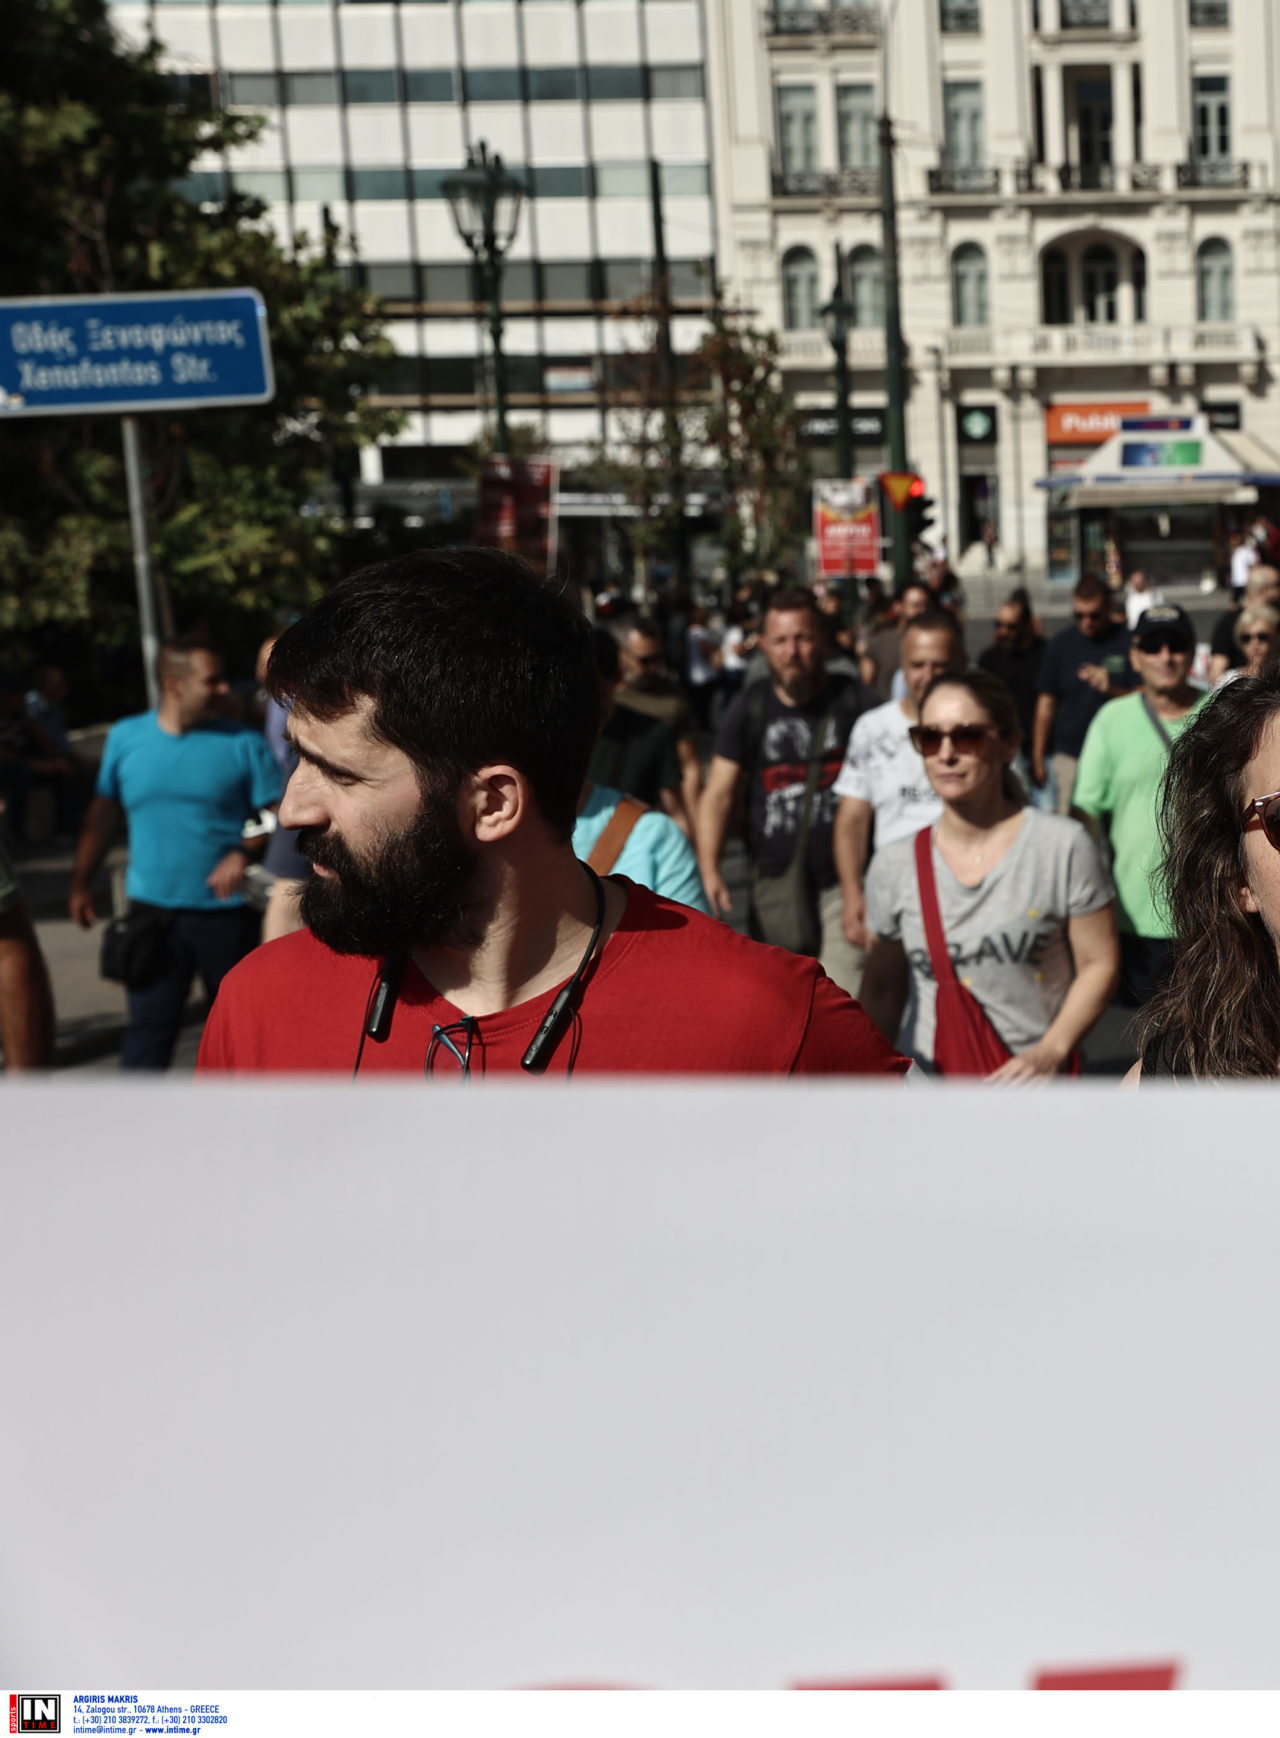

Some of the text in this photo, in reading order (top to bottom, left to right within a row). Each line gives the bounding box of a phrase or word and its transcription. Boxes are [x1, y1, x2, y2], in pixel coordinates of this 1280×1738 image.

[11, 315, 245, 358] Οδός Ξενοφώντος
[18, 353, 218, 391] Xenofontos Str.
[1061, 411, 1121, 433] Publi
